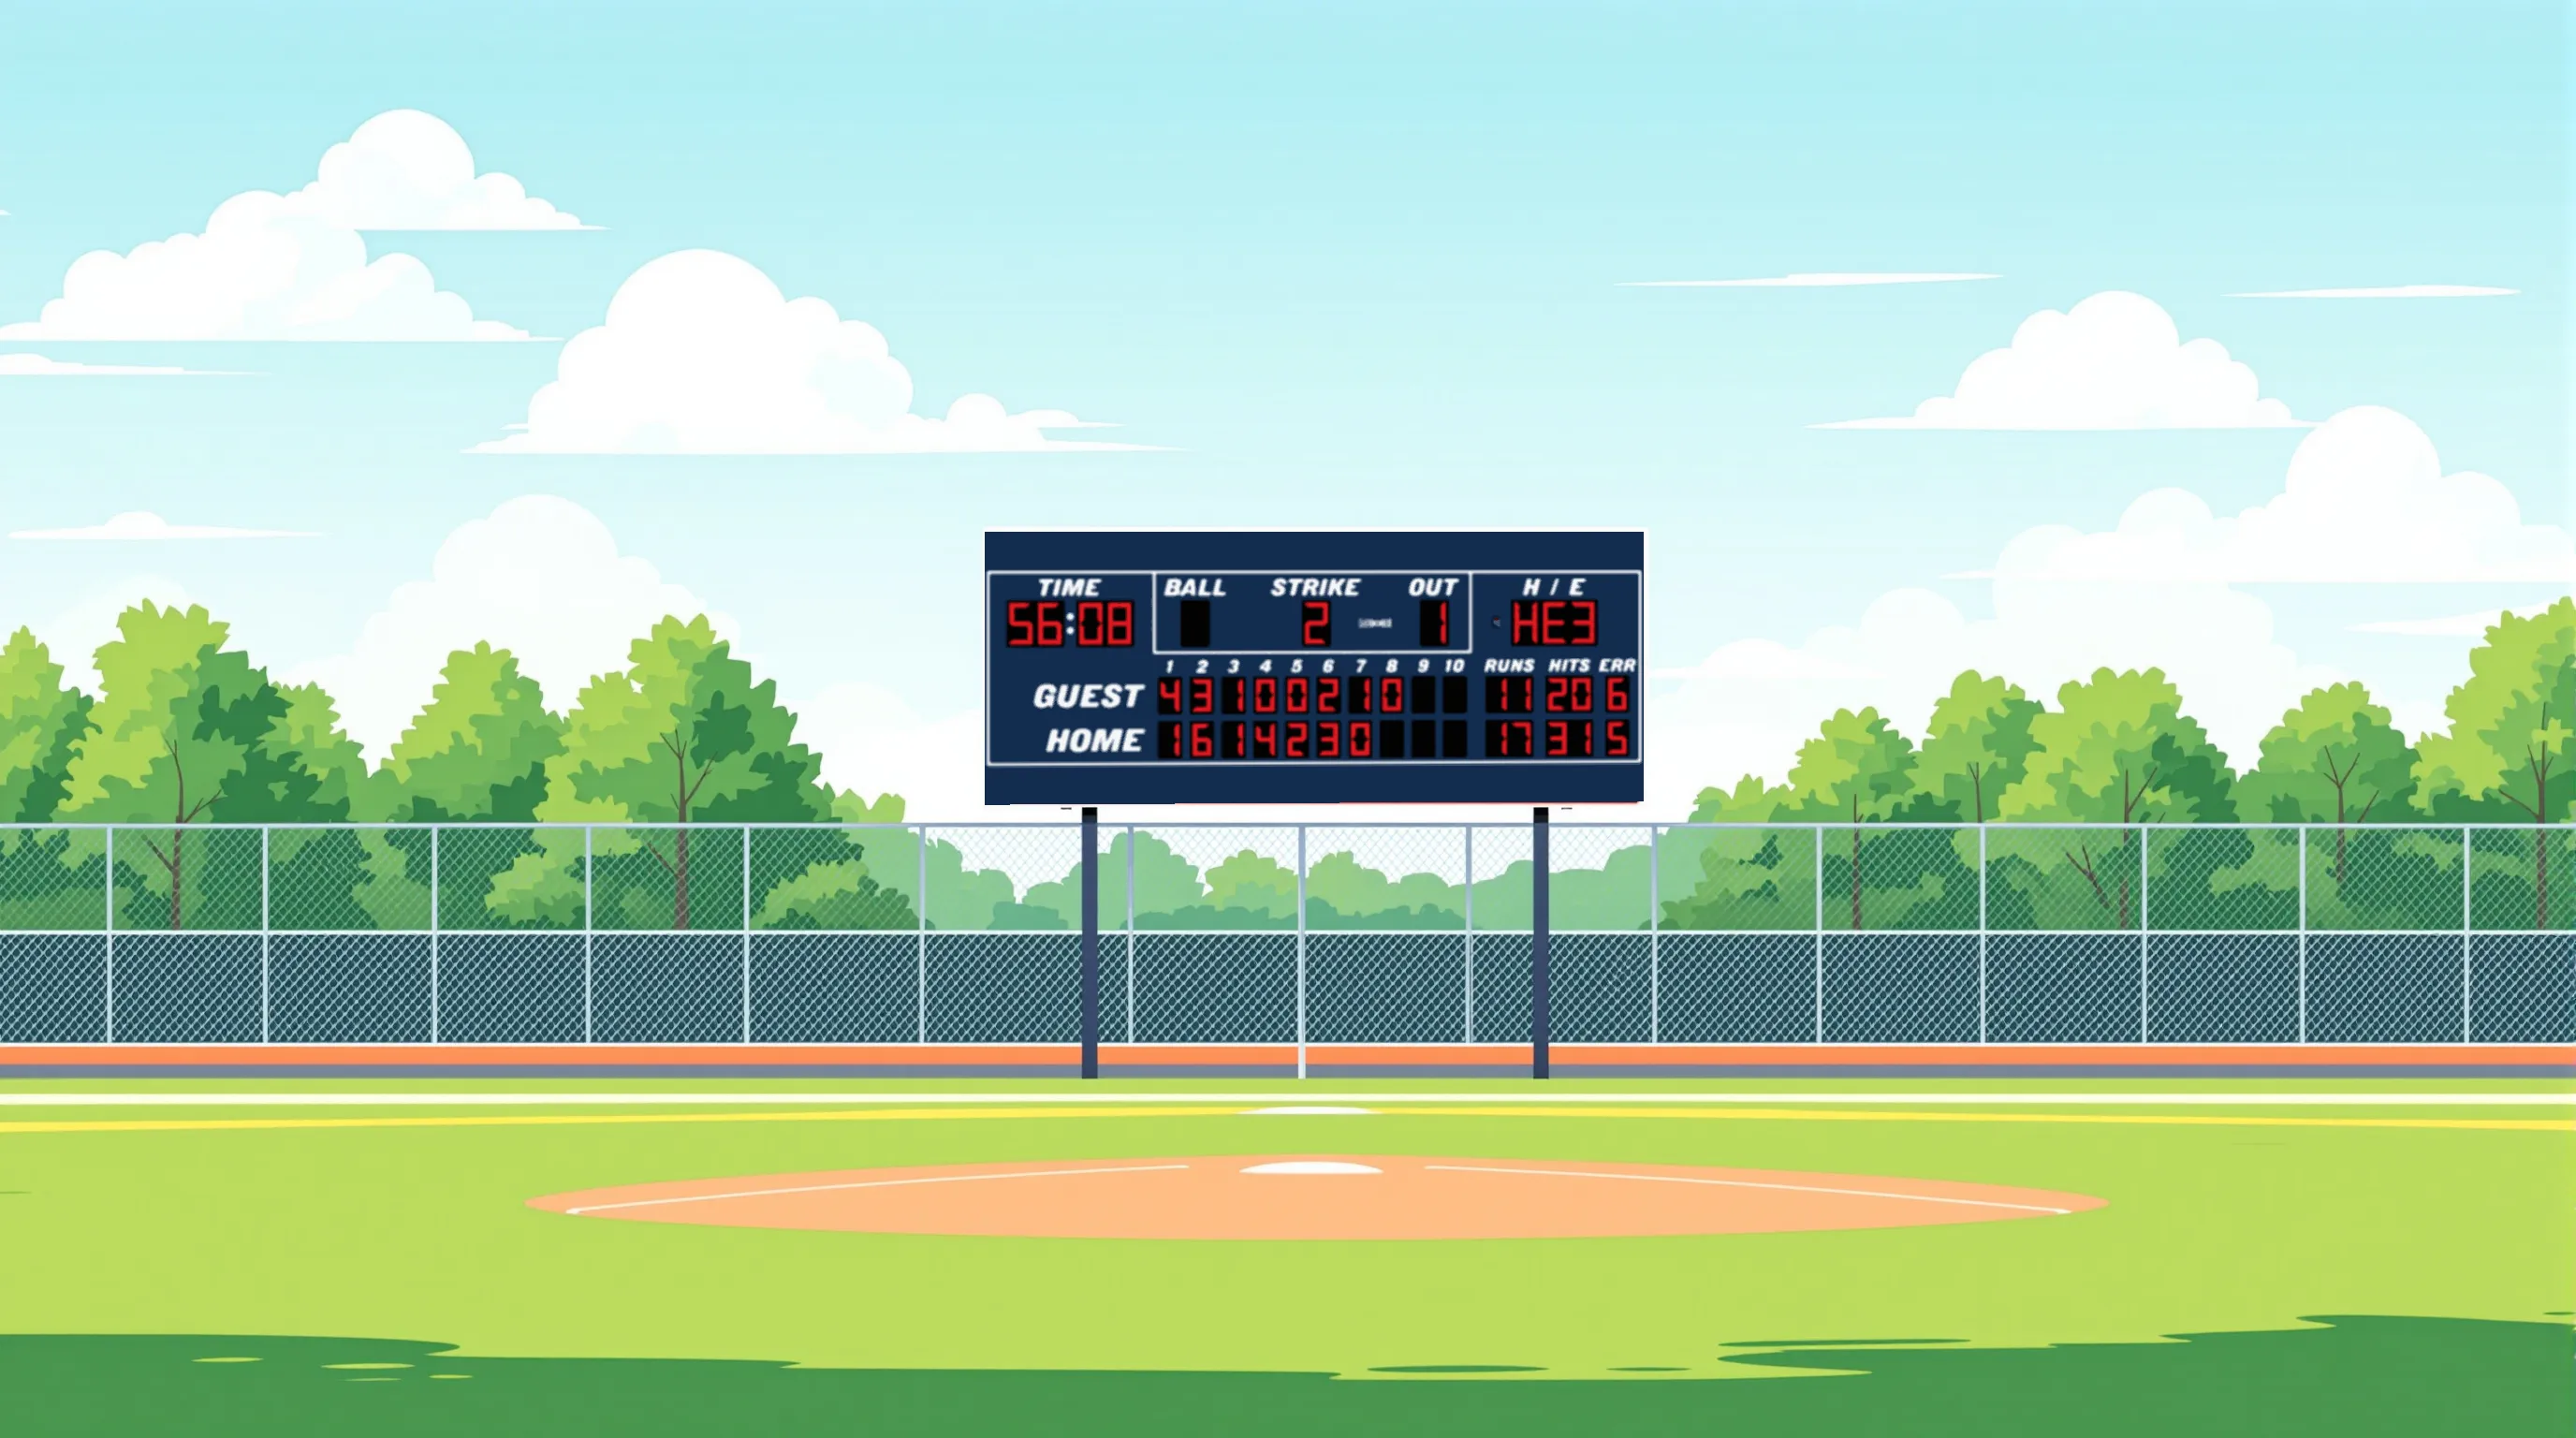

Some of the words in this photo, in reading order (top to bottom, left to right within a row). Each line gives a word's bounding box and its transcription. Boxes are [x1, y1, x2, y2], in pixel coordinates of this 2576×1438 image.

[1038, 578, 1102, 597] TIME
[1164, 578, 1226, 597] BALL
[1270, 578, 1362, 597] STRIKE
[1408, 578, 1459, 597] OUT
[1522, 578, 1541, 596] H
[1549, 578, 1559, 596] /
[1569, 578, 1587, 596] E
[1008, 602, 1132, 646] 56:08
[1304, 601, 1329, 645] 2
[1166, 659, 1174, 674] 1
[1195, 659, 1209, 674] 2
[1227, 659, 1240, 674] 3
[1259, 659, 1272, 673] 4
[1291, 658, 1303, 674] 5
[1323, 658, 1335, 674] 6
[1356, 658, 1368, 673] 7
[1385, 658, 1398, 673] 8
[1417, 658, 1430, 673] 9
[1445, 658, 1465, 673] 10
[1484, 658, 1535, 673] RUNS
[1548, 658, 1591, 673] HITS
[1598, 658, 1637, 672] ERR
[1033, 683, 1146, 709] GUEST
[1160, 680, 1180, 712] 4
[1193, 679, 1212, 712] 3
[1255, 678, 1276, 712] 0
[1287, 678, 1308, 712] 0
[1318, 678, 1339, 712] 2
[1382, 678, 1402, 712] 0
[1500, 679, 1531, 711] 11
[1547, 677, 1591, 712] 20
[1607, 677, 1628, 712] 6
[1046, 727, 1146, 753] HOME
[1192, 723, 1212, 757] 6
[1255, 724, 1276, 756] 4
[1287, 722, 1308, 757] 2
[1320, 722, 1339, 756] 3
[1350, 722, 1370, 756] 0
[1500, 722, 1531, 755] 17
[1548, 721, 1591, 756] 31
[1607, 721, 1628, 756] 5
